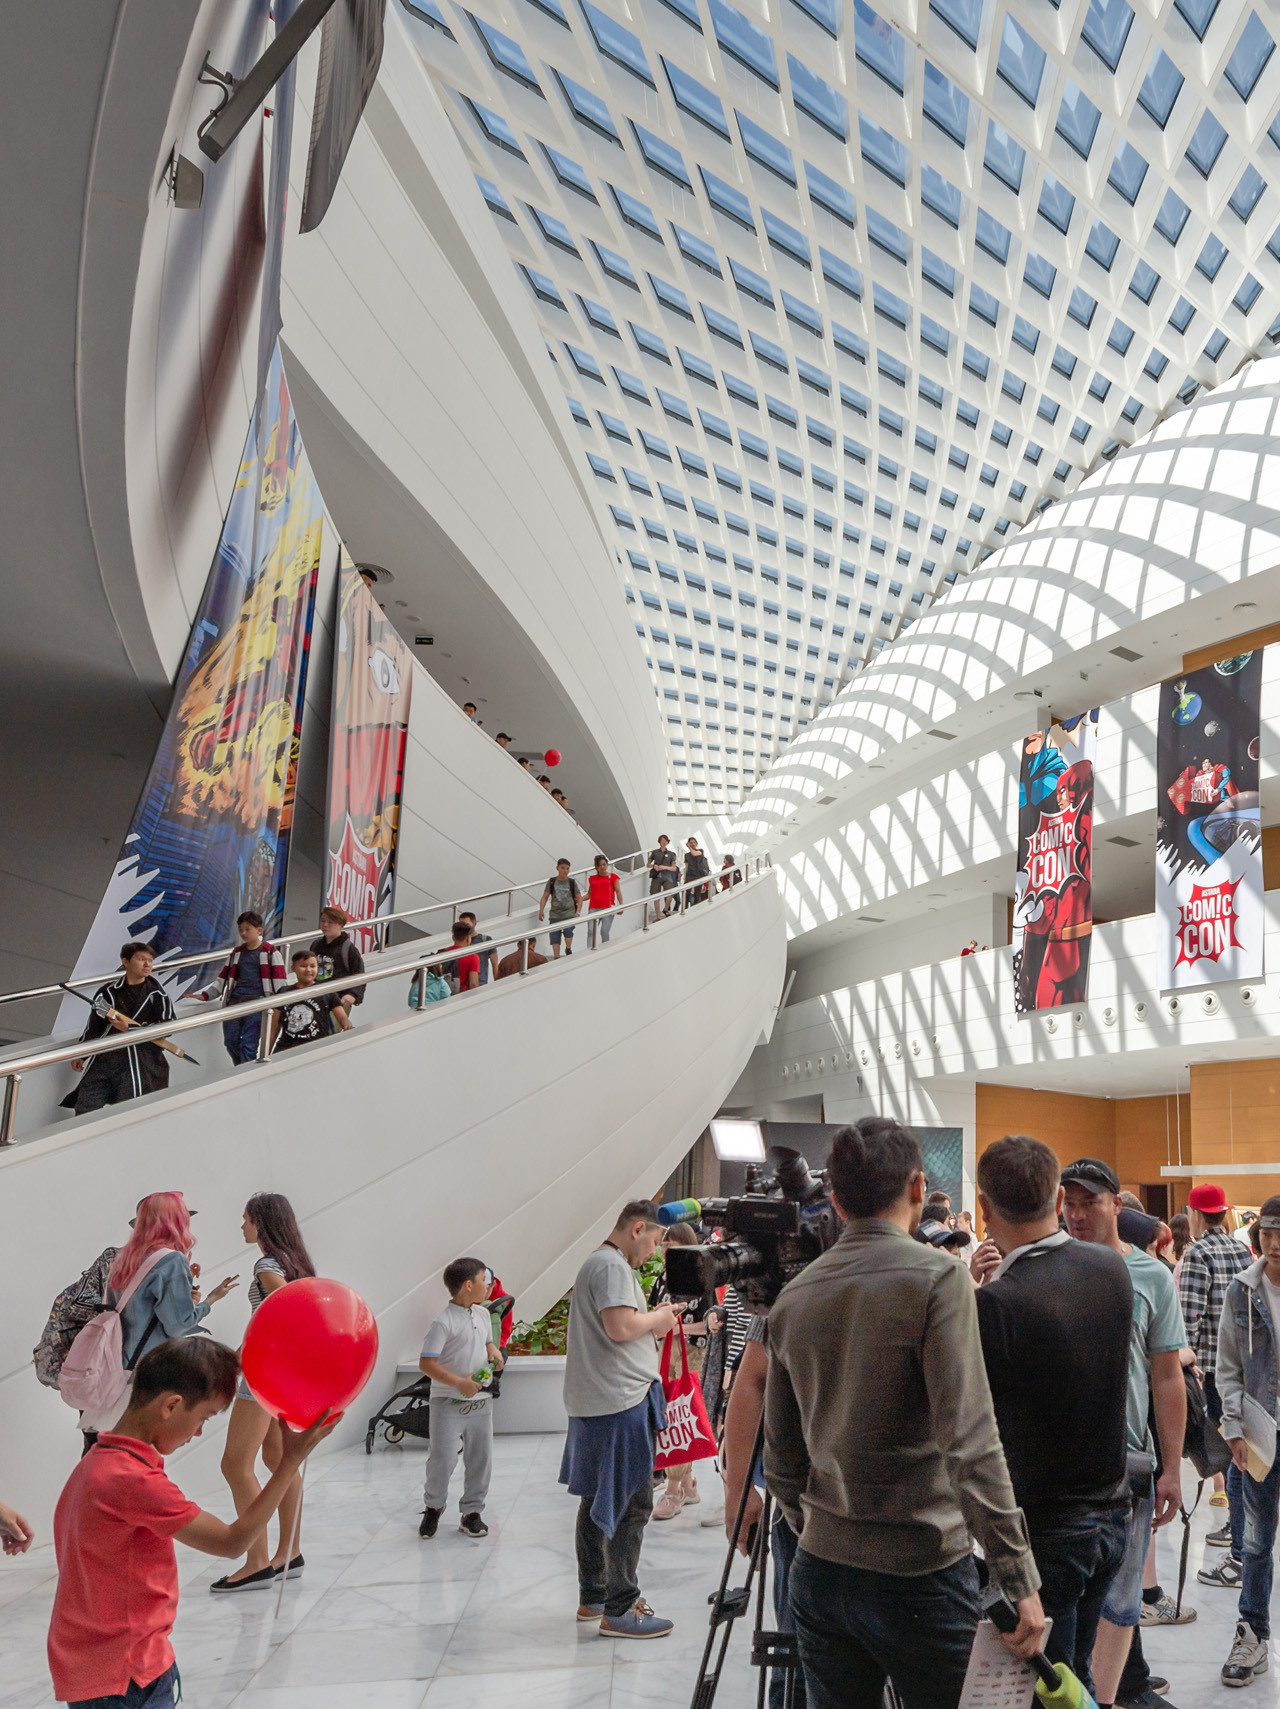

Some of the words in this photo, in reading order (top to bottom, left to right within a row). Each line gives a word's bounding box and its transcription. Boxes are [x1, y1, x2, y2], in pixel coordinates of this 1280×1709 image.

[1033, 822, 1072, 854] COM!C
[1032, 846, 1070, 888] CON
[1183, 894, 1232, 923] COM!C
[1183, 918, 1231, 958] CON
[664, 1404, 690, 1424] M!C
[657, 1420, 695, 1450] CON
